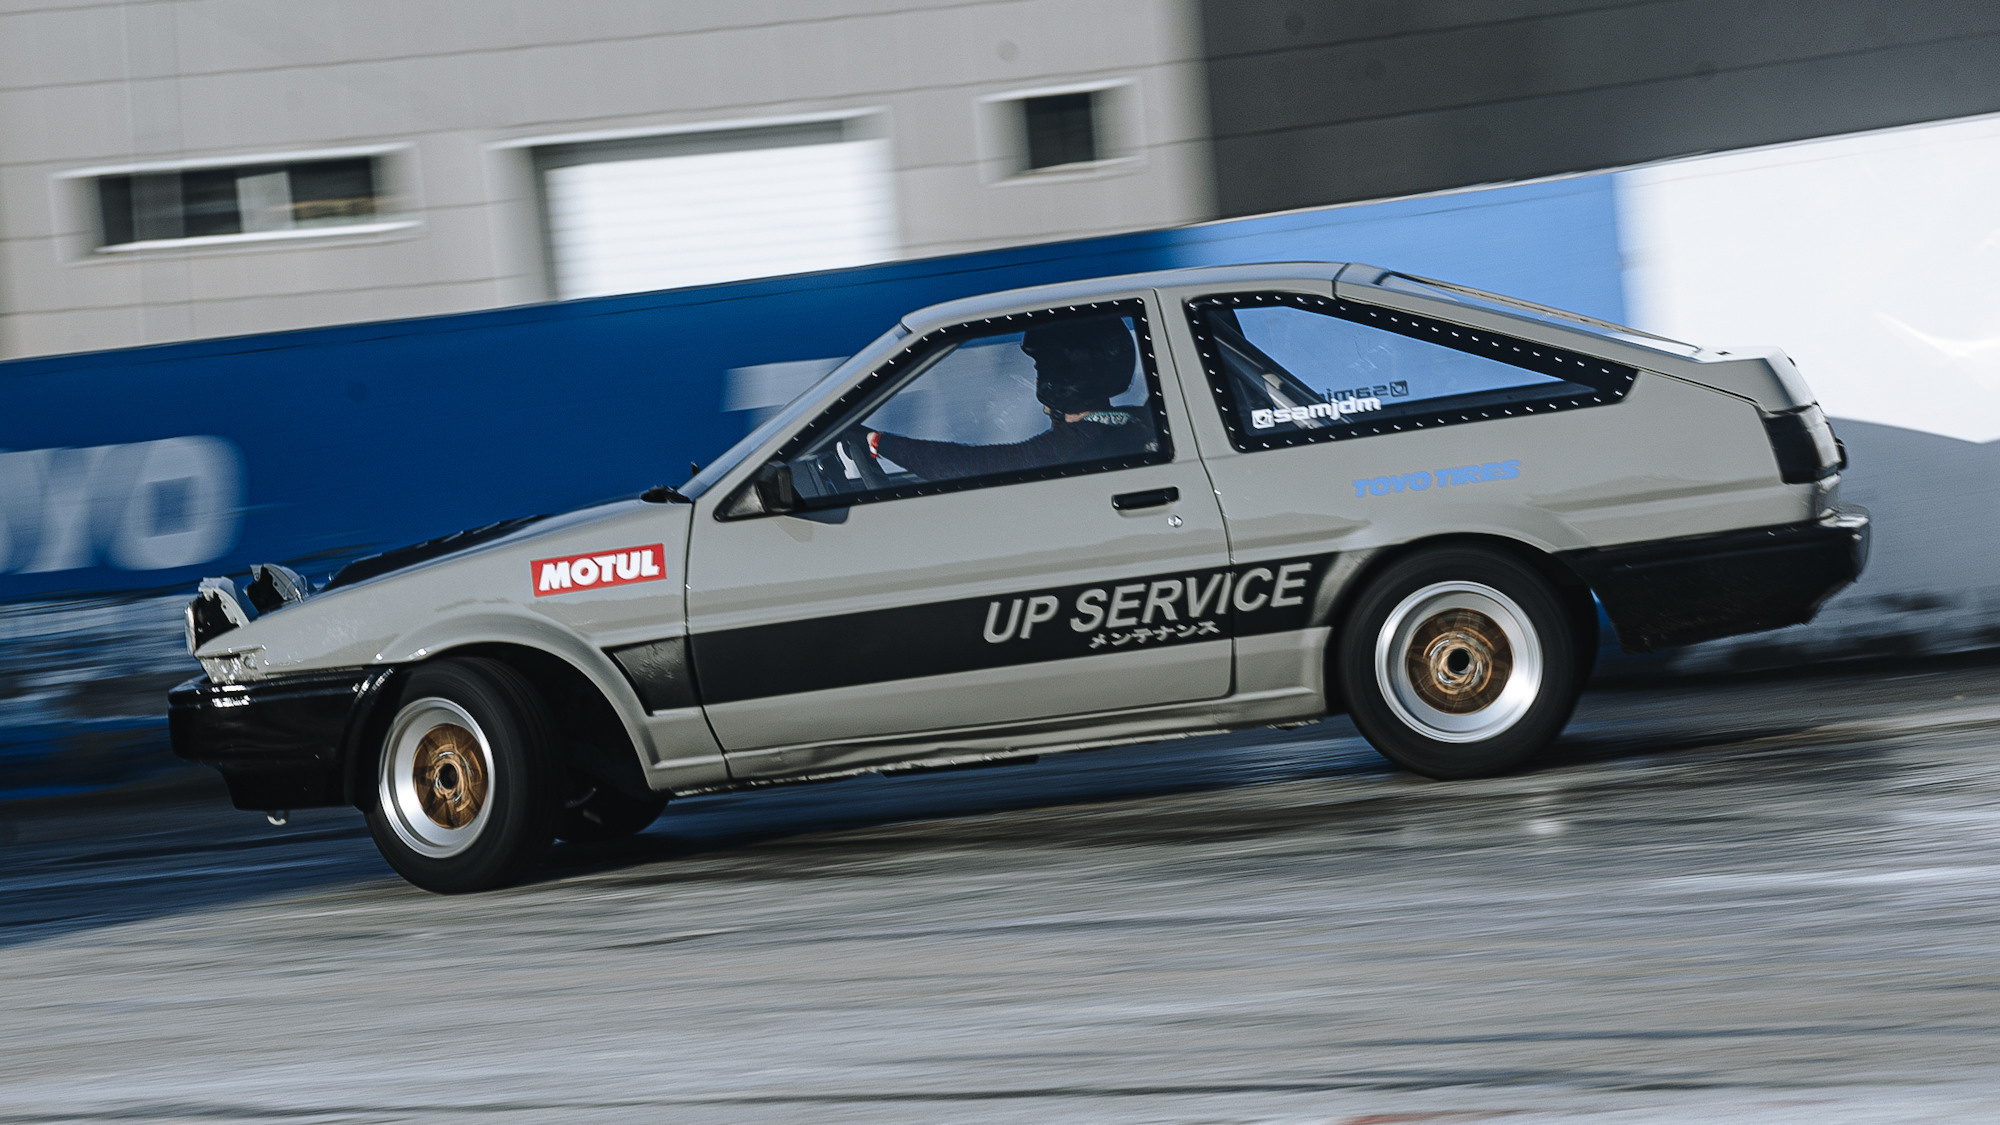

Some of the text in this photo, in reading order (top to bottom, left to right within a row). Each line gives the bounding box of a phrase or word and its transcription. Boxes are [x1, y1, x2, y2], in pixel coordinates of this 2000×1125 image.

[1274, 396, 1382, 421] samjdm
[1352, 460, 1521, 498] TOYO TIRES
[539, 549, 660, 591] MOTUL
[983, 562, 1312, 644] UP SERVICE
[1089, 620, 1220, 649] メンテナンス
